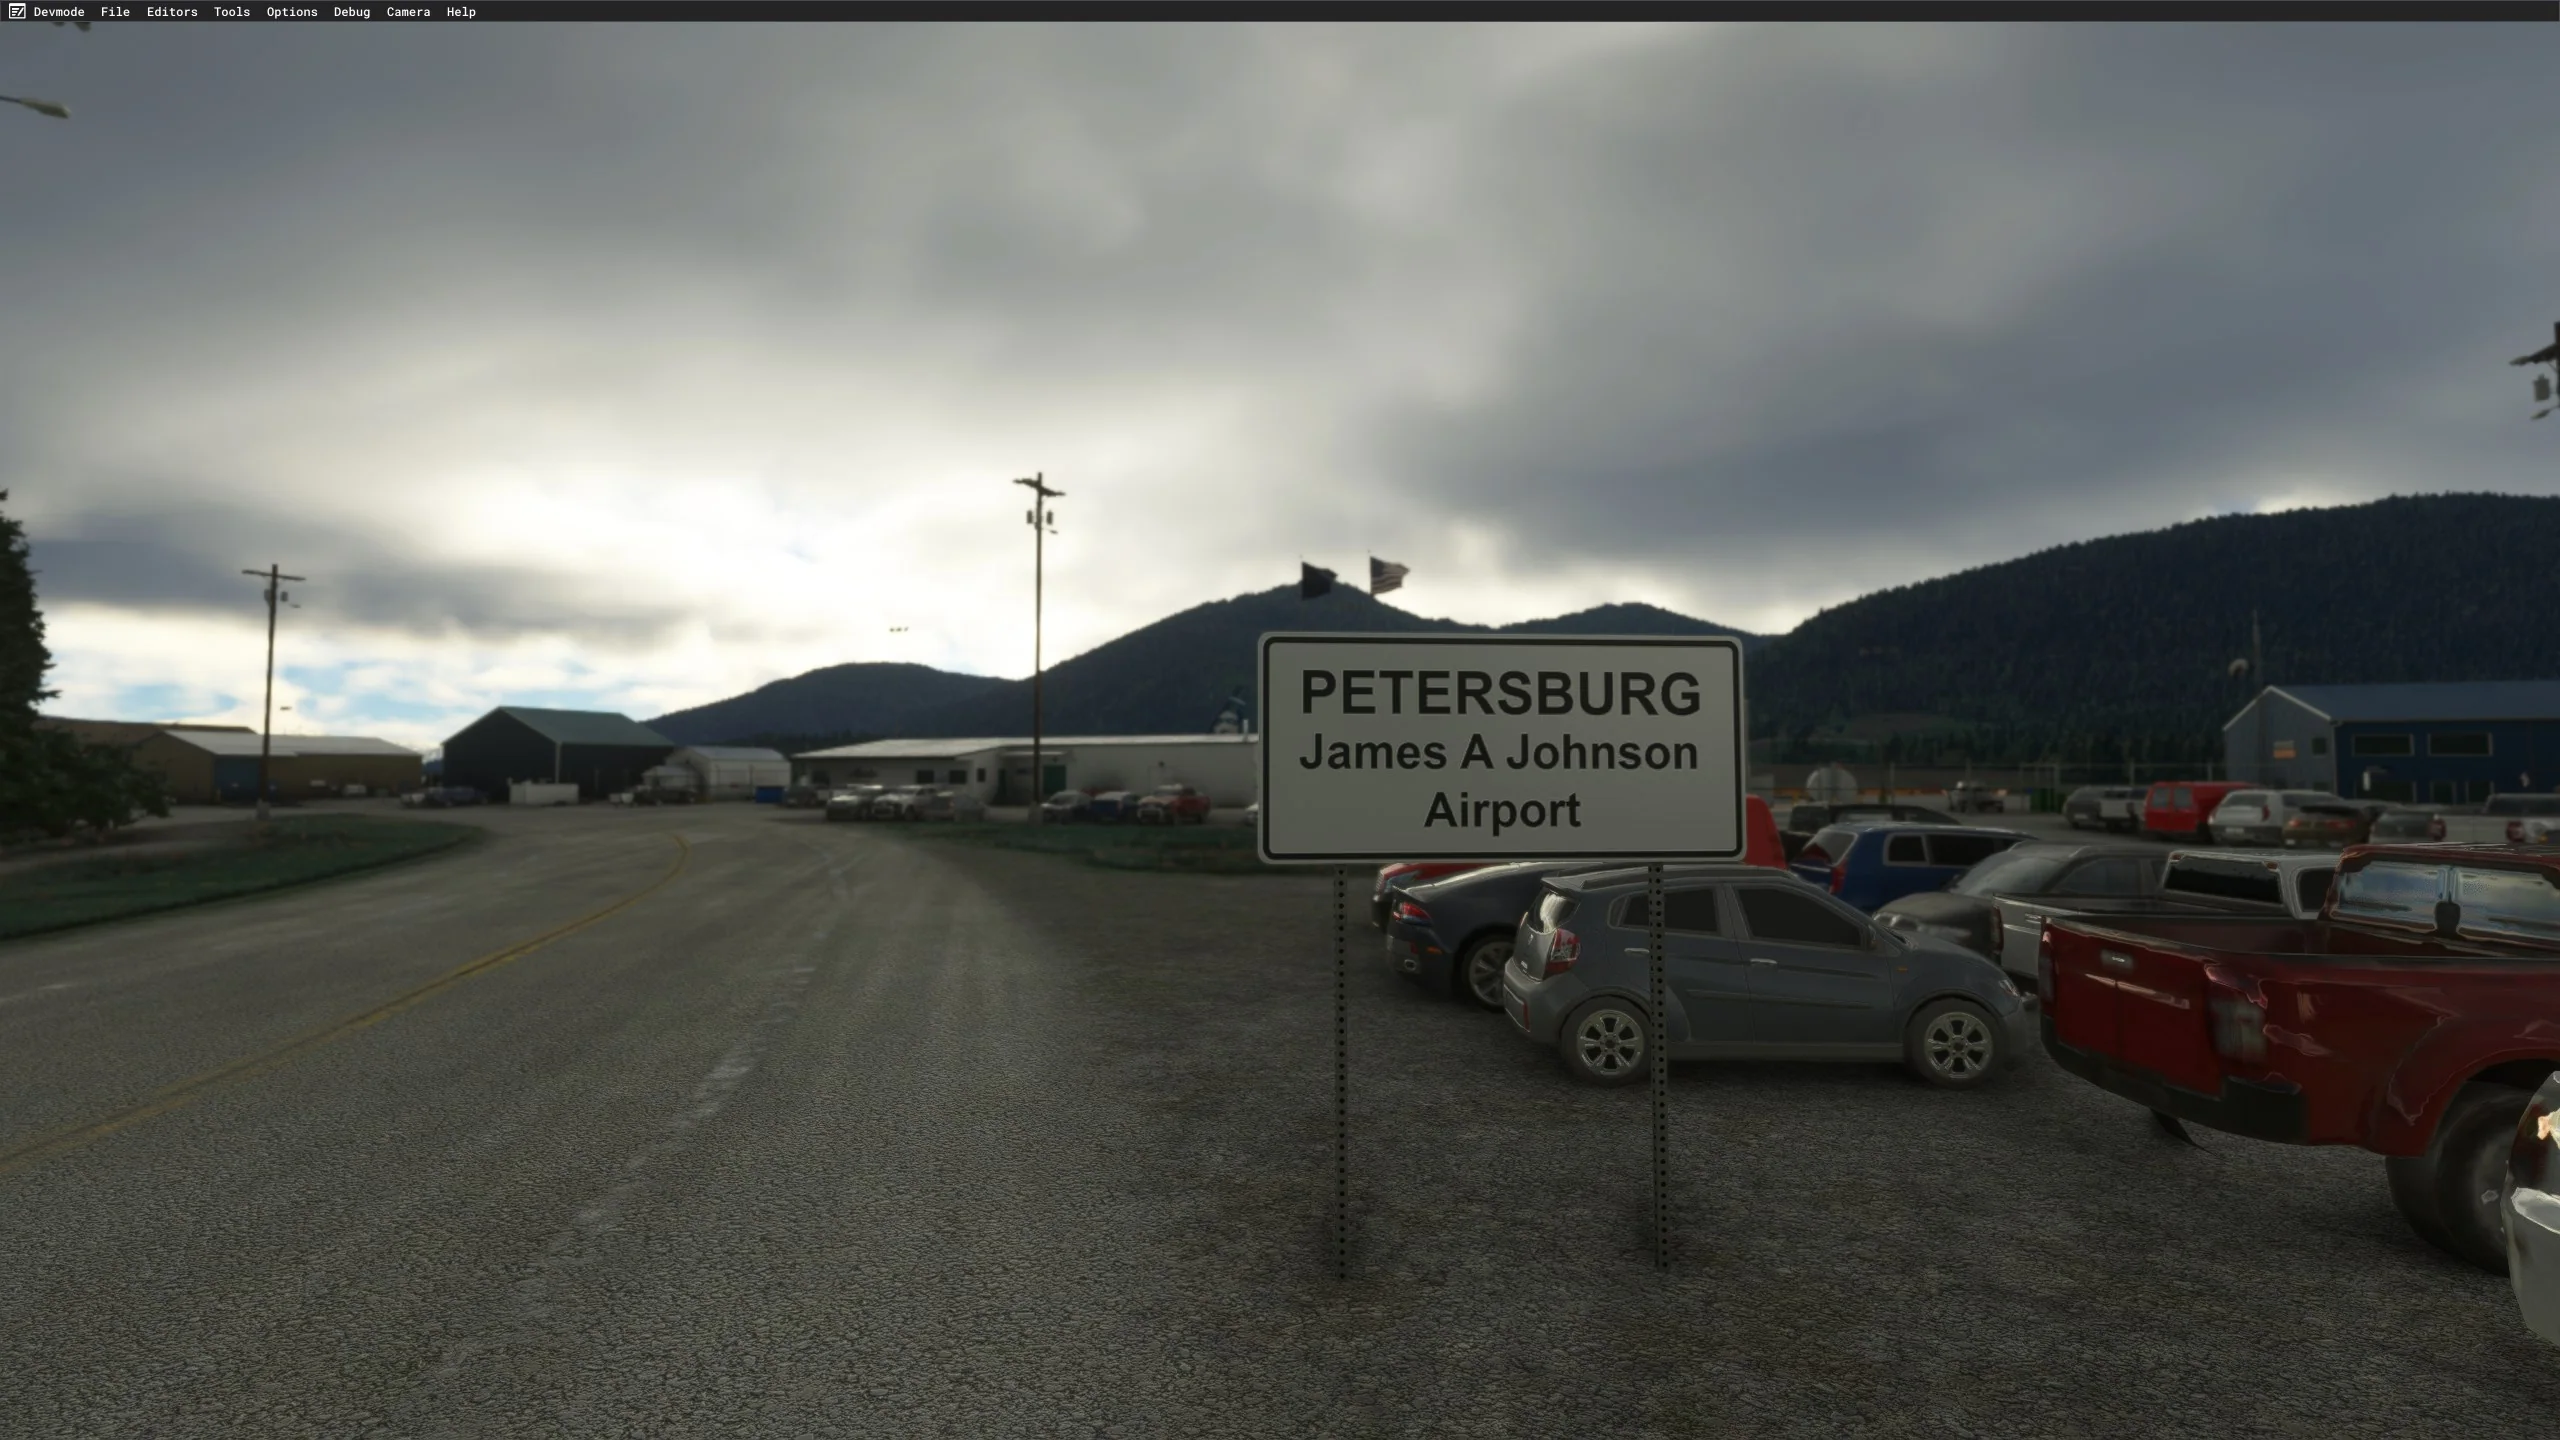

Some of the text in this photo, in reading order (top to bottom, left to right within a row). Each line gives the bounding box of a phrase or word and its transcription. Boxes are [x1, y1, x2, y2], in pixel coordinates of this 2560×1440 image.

[1302, 669, 1701, 716] PETERSBURG
[1299, 732, 1699, 770] James A Johnson
[1423, 791, 1583, 837] Airport
